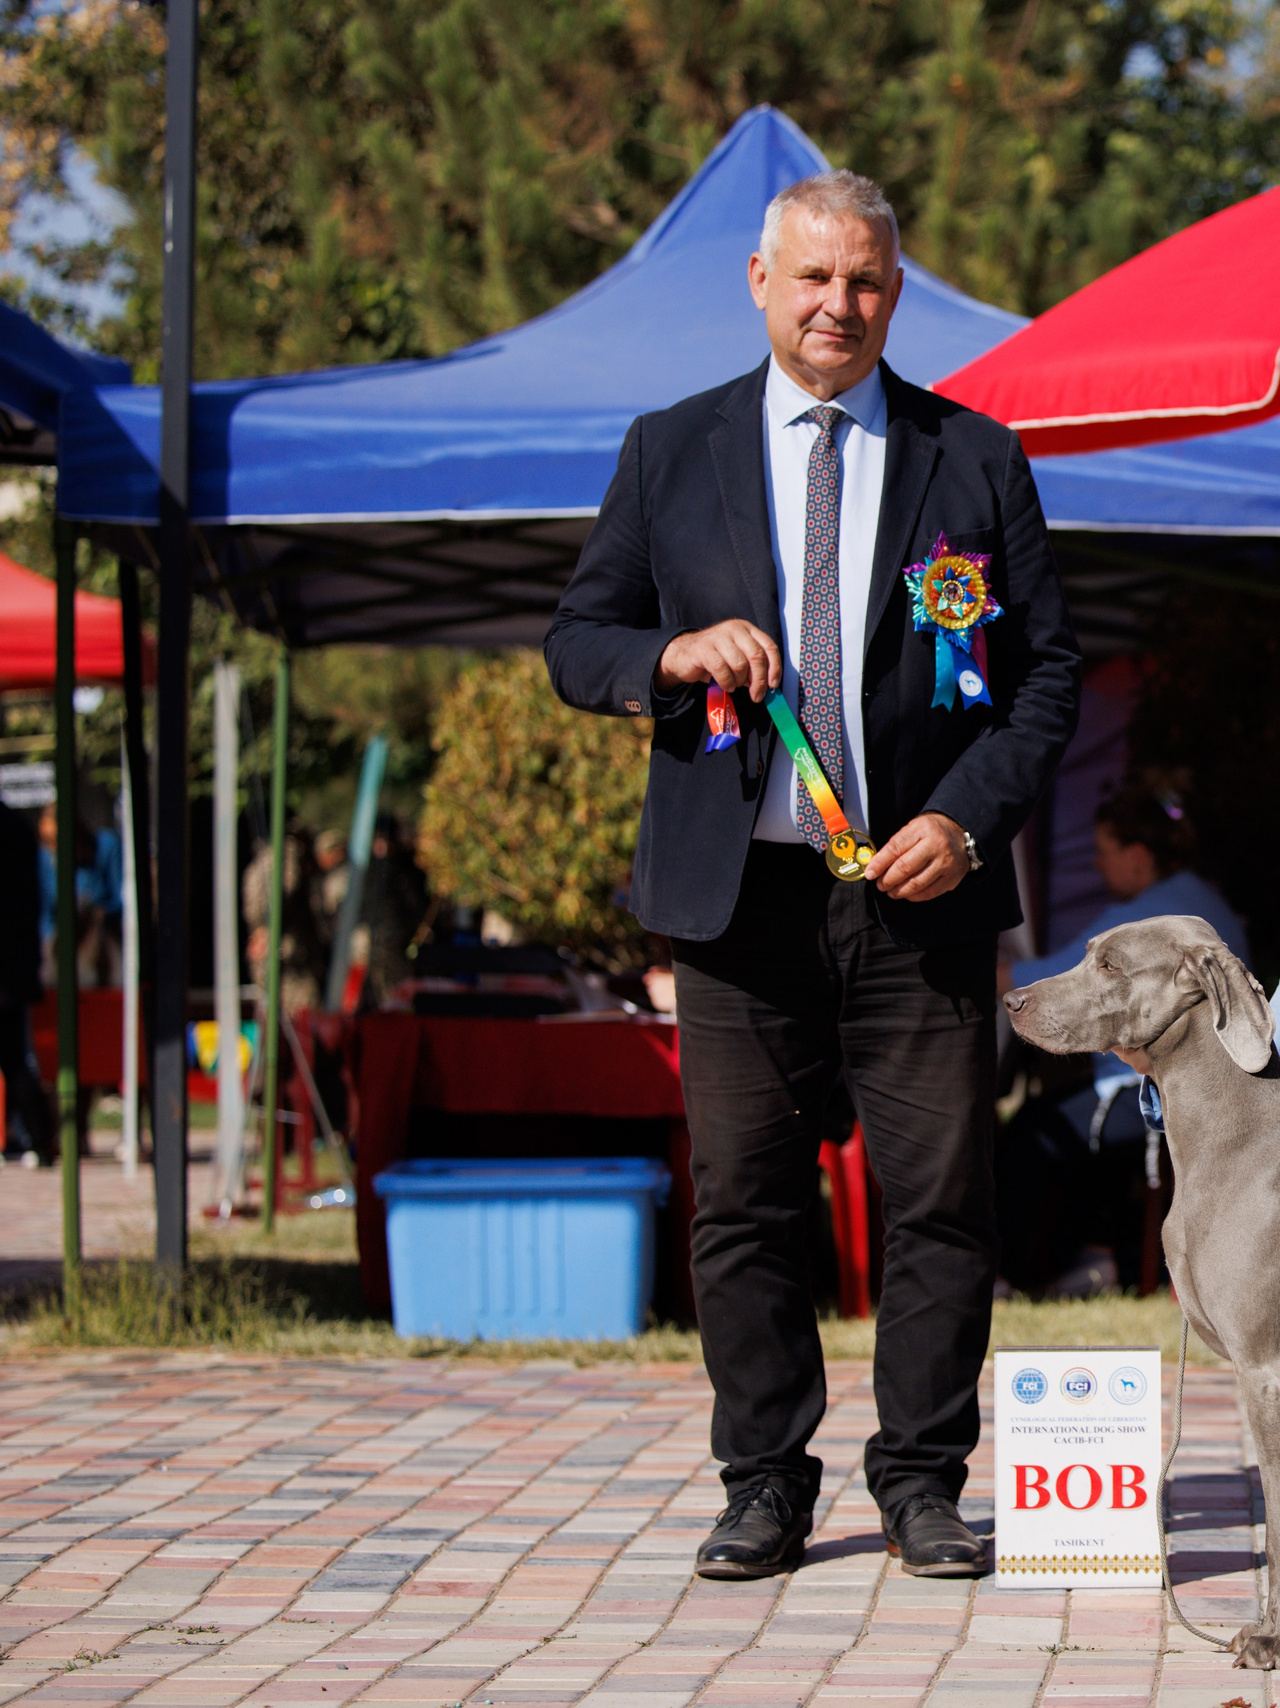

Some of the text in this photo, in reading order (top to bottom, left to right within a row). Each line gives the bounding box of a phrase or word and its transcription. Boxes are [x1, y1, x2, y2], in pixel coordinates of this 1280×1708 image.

[1022, 1382, 1038, 1390] FCI
[1069, 1382, 1089, 1391] FCI
[1011, 1425, 1147, 1434] INTERNATIONAL DOG SHOW
[1054, 1436, 1104, 1444] CACIB-FCI
[1010, 1464, 1147, 1510] BOB
[1053, 1538, 1106, 1547] TASHKENT
